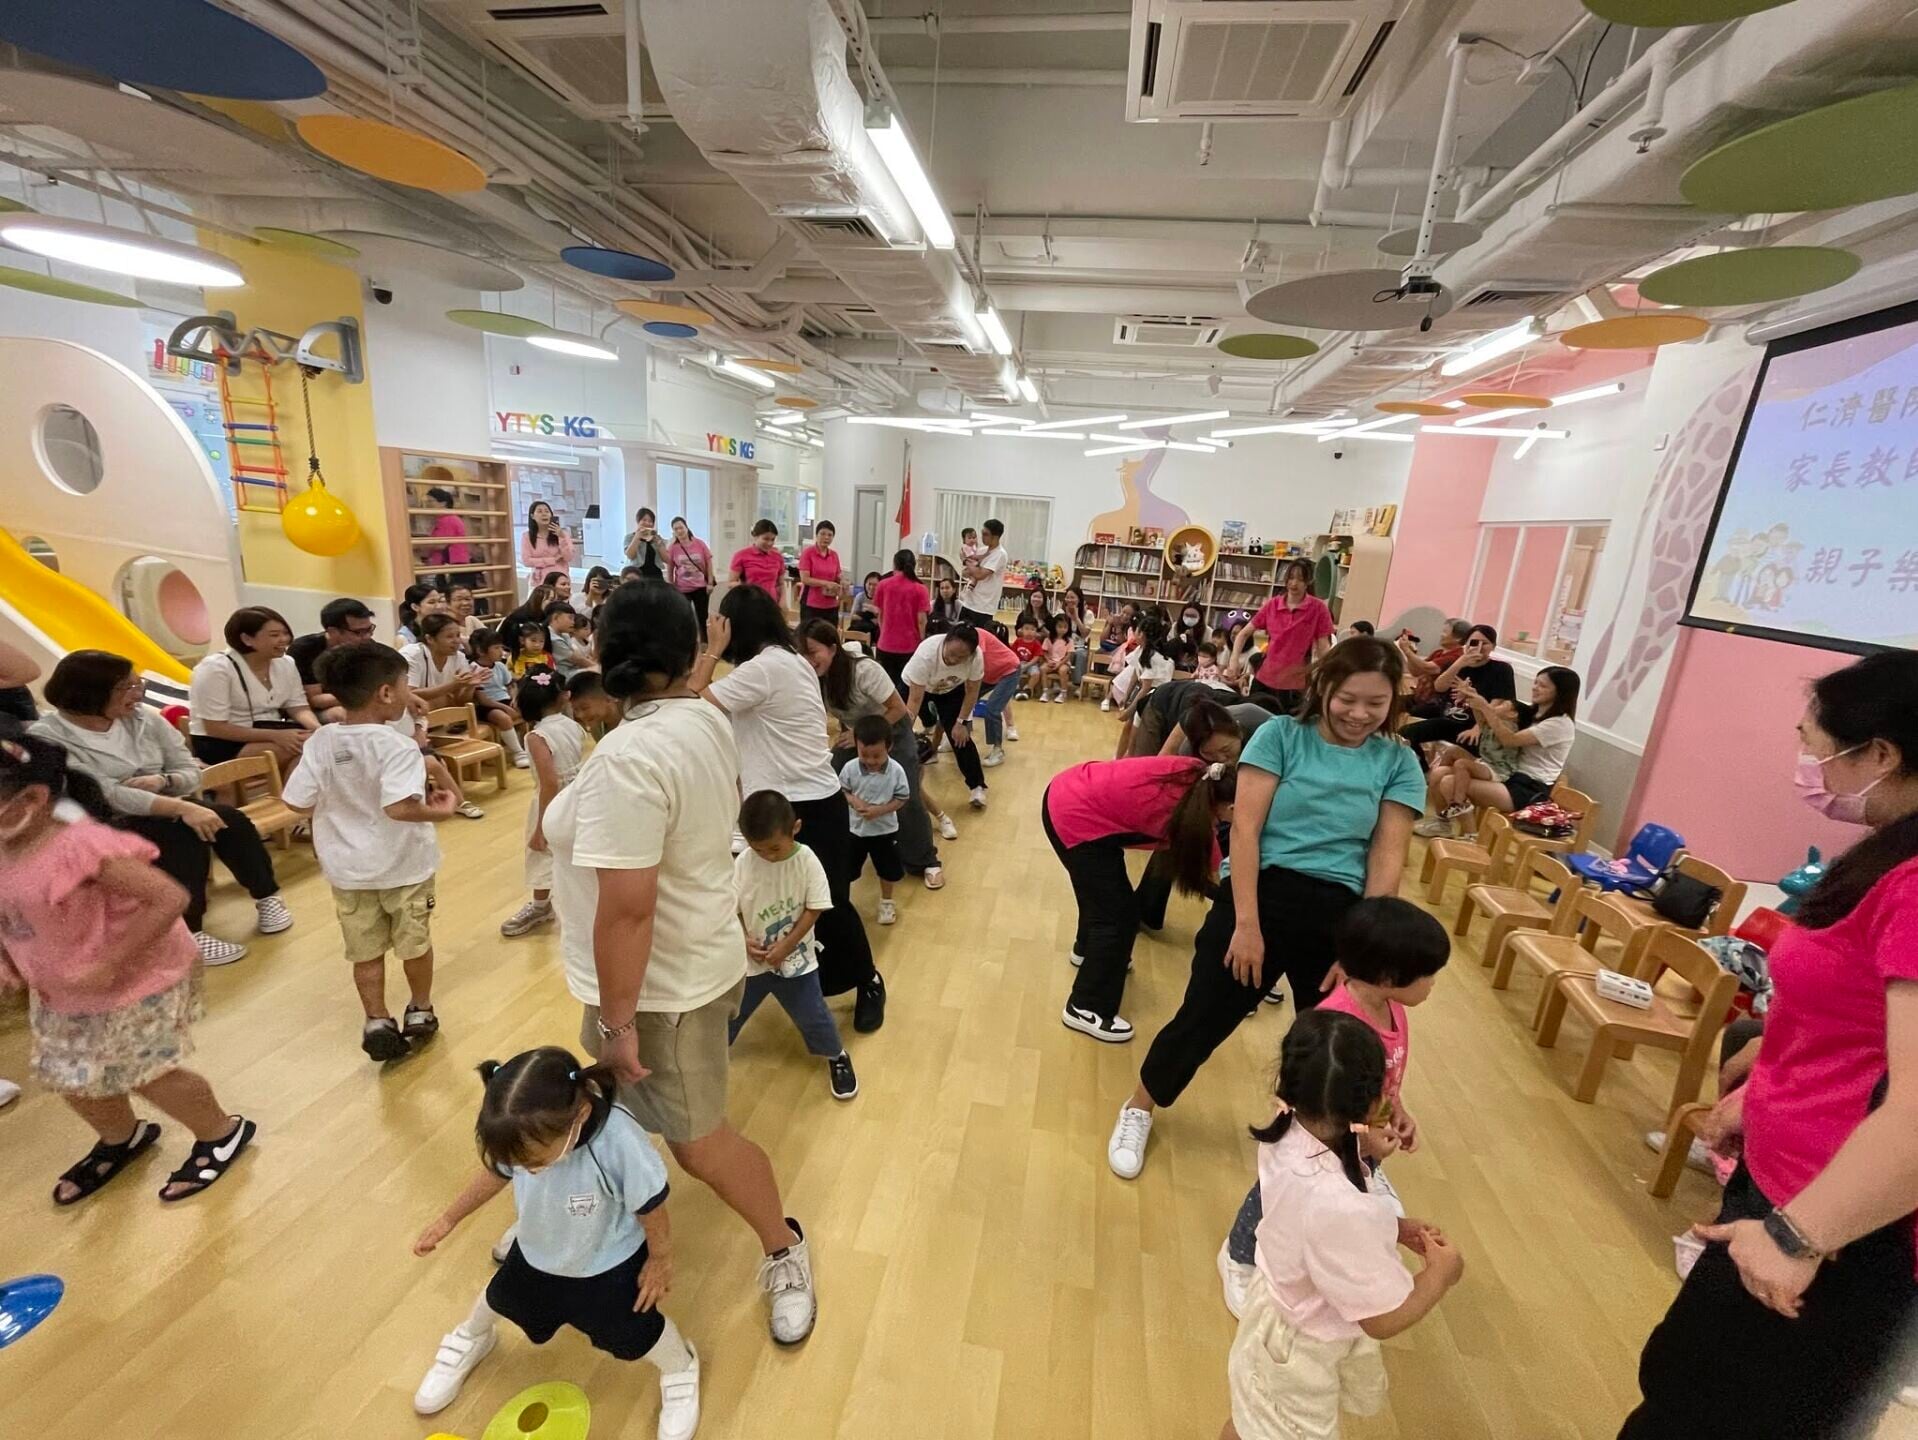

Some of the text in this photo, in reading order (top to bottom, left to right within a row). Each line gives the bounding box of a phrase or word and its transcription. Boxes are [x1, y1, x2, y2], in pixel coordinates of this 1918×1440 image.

[496, 411, 596, 438] YTYS KG
[707, 432, 755, 459] YTYS KG
